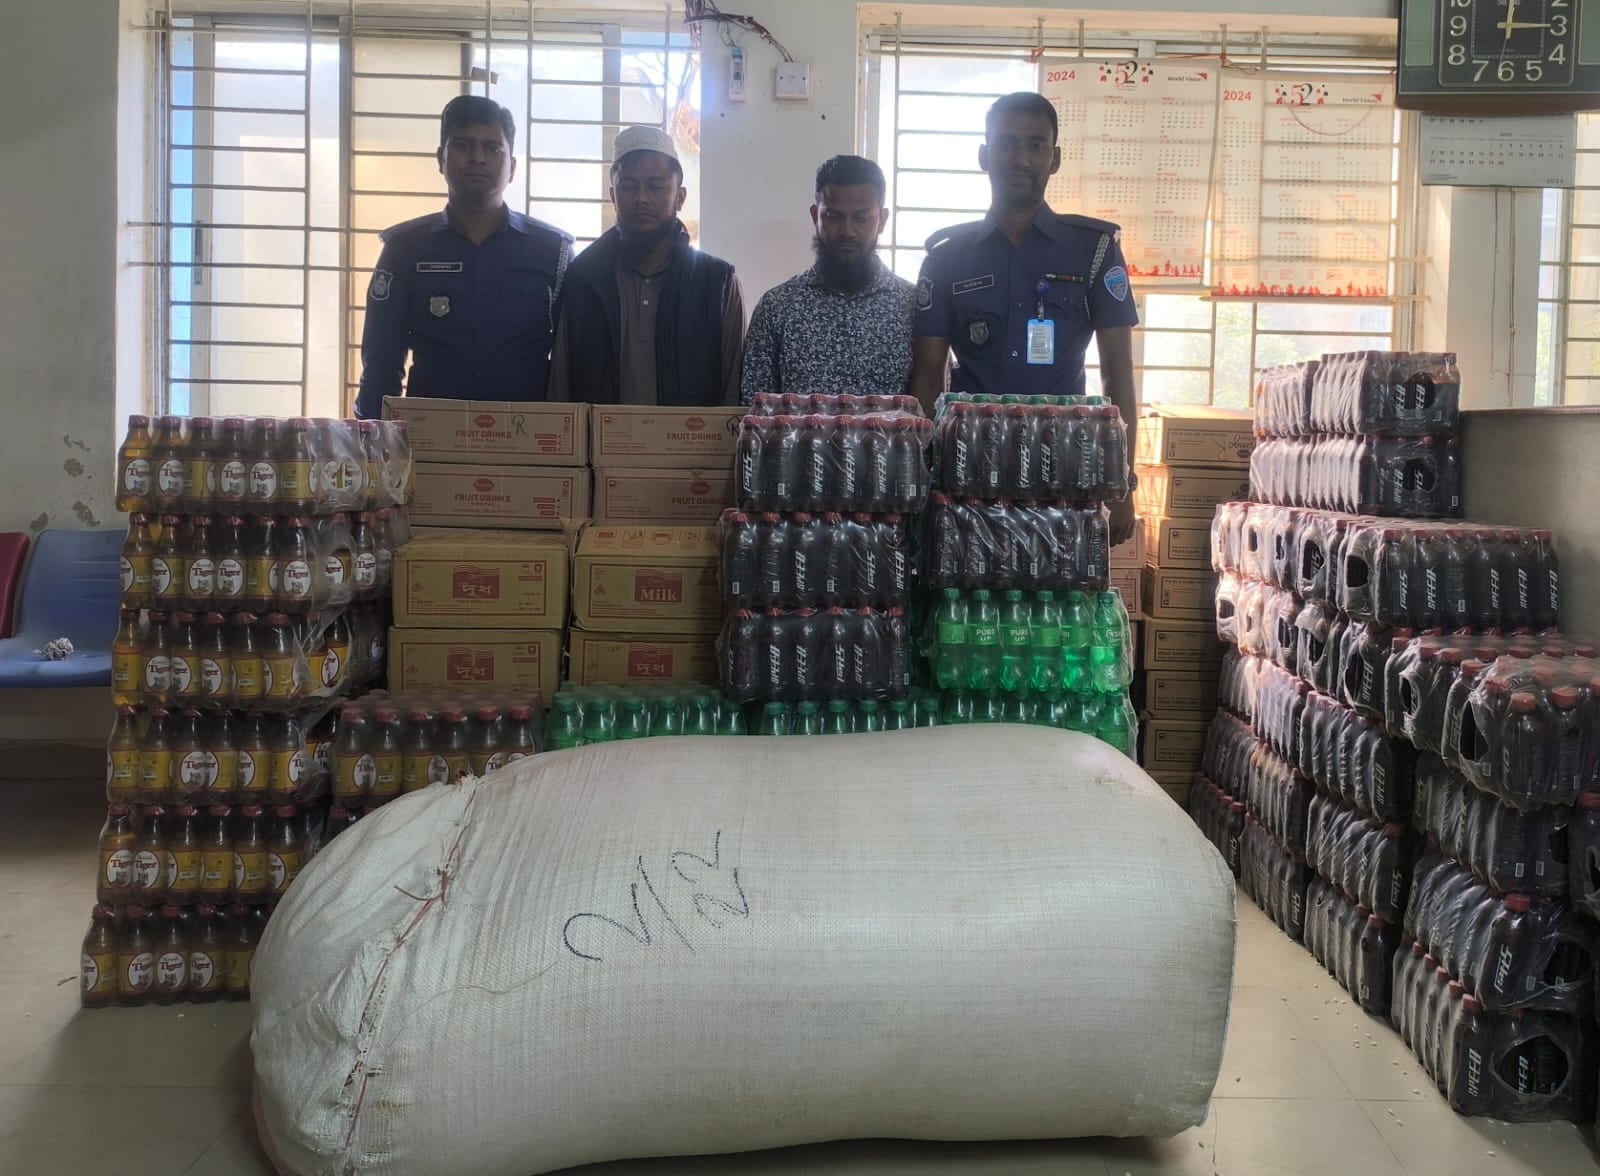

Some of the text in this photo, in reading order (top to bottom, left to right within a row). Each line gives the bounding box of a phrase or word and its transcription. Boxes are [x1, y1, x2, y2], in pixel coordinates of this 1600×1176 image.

[1450, 15, 1467, 37] 9
[1550, 14, 1567, 36] 3
[1448, 44, 1466, 65] 8
[1548, 43, 1566, 65] 4
[1047, 70, 1076, 82] 2024
[1472, 60, 1489, 82] 7
[1497, 60, 1514, 81] 6
[1525, 60, 1543, 81] 5
[1223, 90, 1252, 101] 2024
[640, 589, 678, 601] Milk
[1468, 1047, 1482, 1096] SPEED
